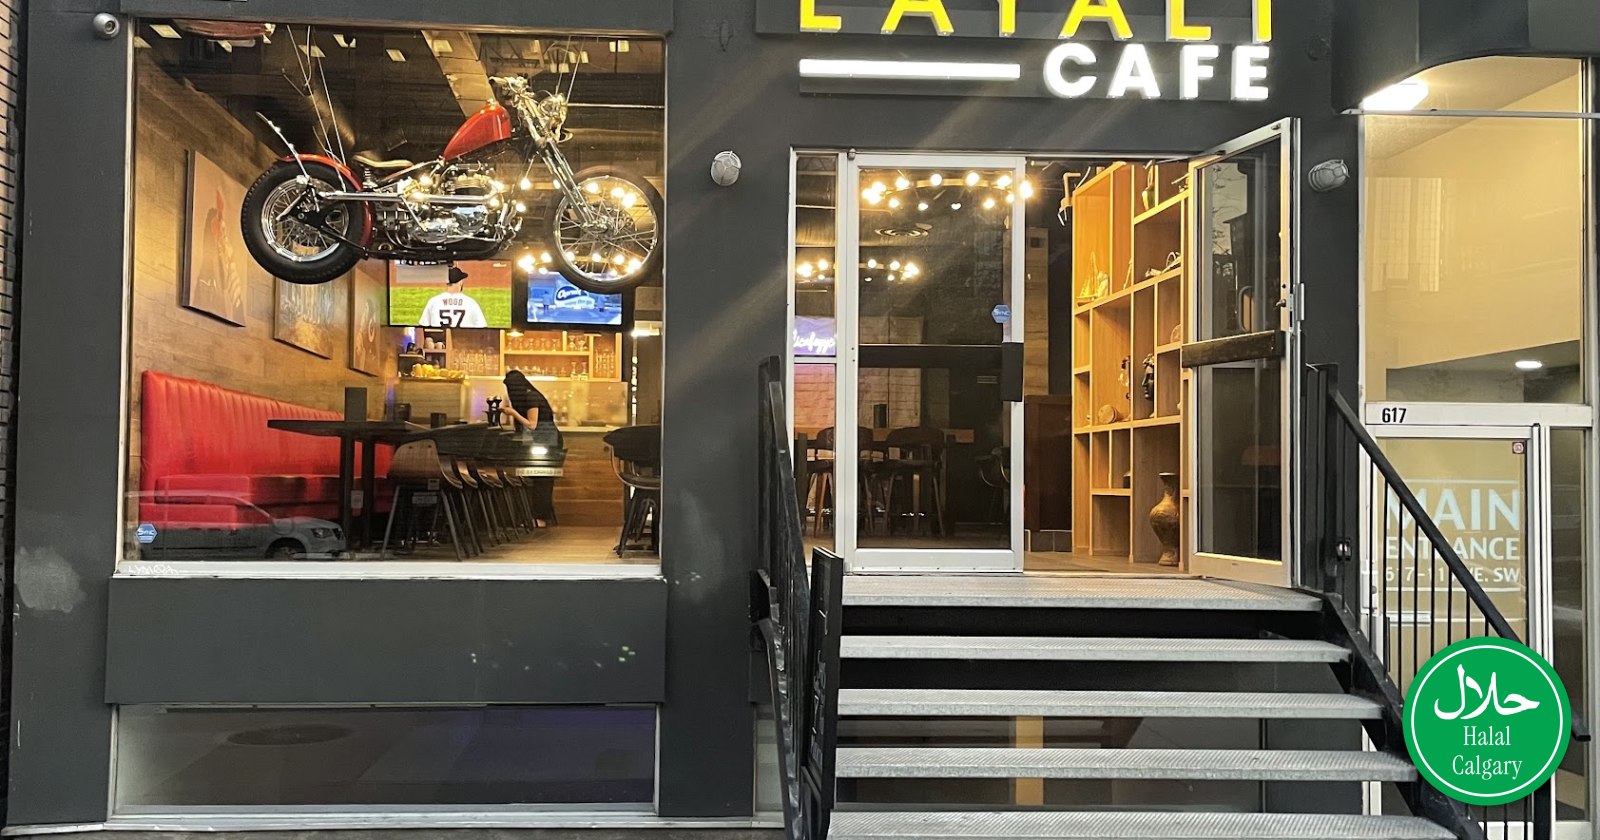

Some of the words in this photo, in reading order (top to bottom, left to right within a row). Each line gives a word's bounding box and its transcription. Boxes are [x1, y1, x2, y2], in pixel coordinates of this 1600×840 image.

[1043, 43, 1271, 100] CAFE
[442, 298, 463, 306] WOOD
[439, 309, 466, 328] 57
[1382, 407, 1407, 424] 617
[1386, 536, 1520, 561] ENTANCE
[1493, 567, 1520, 582] SW
